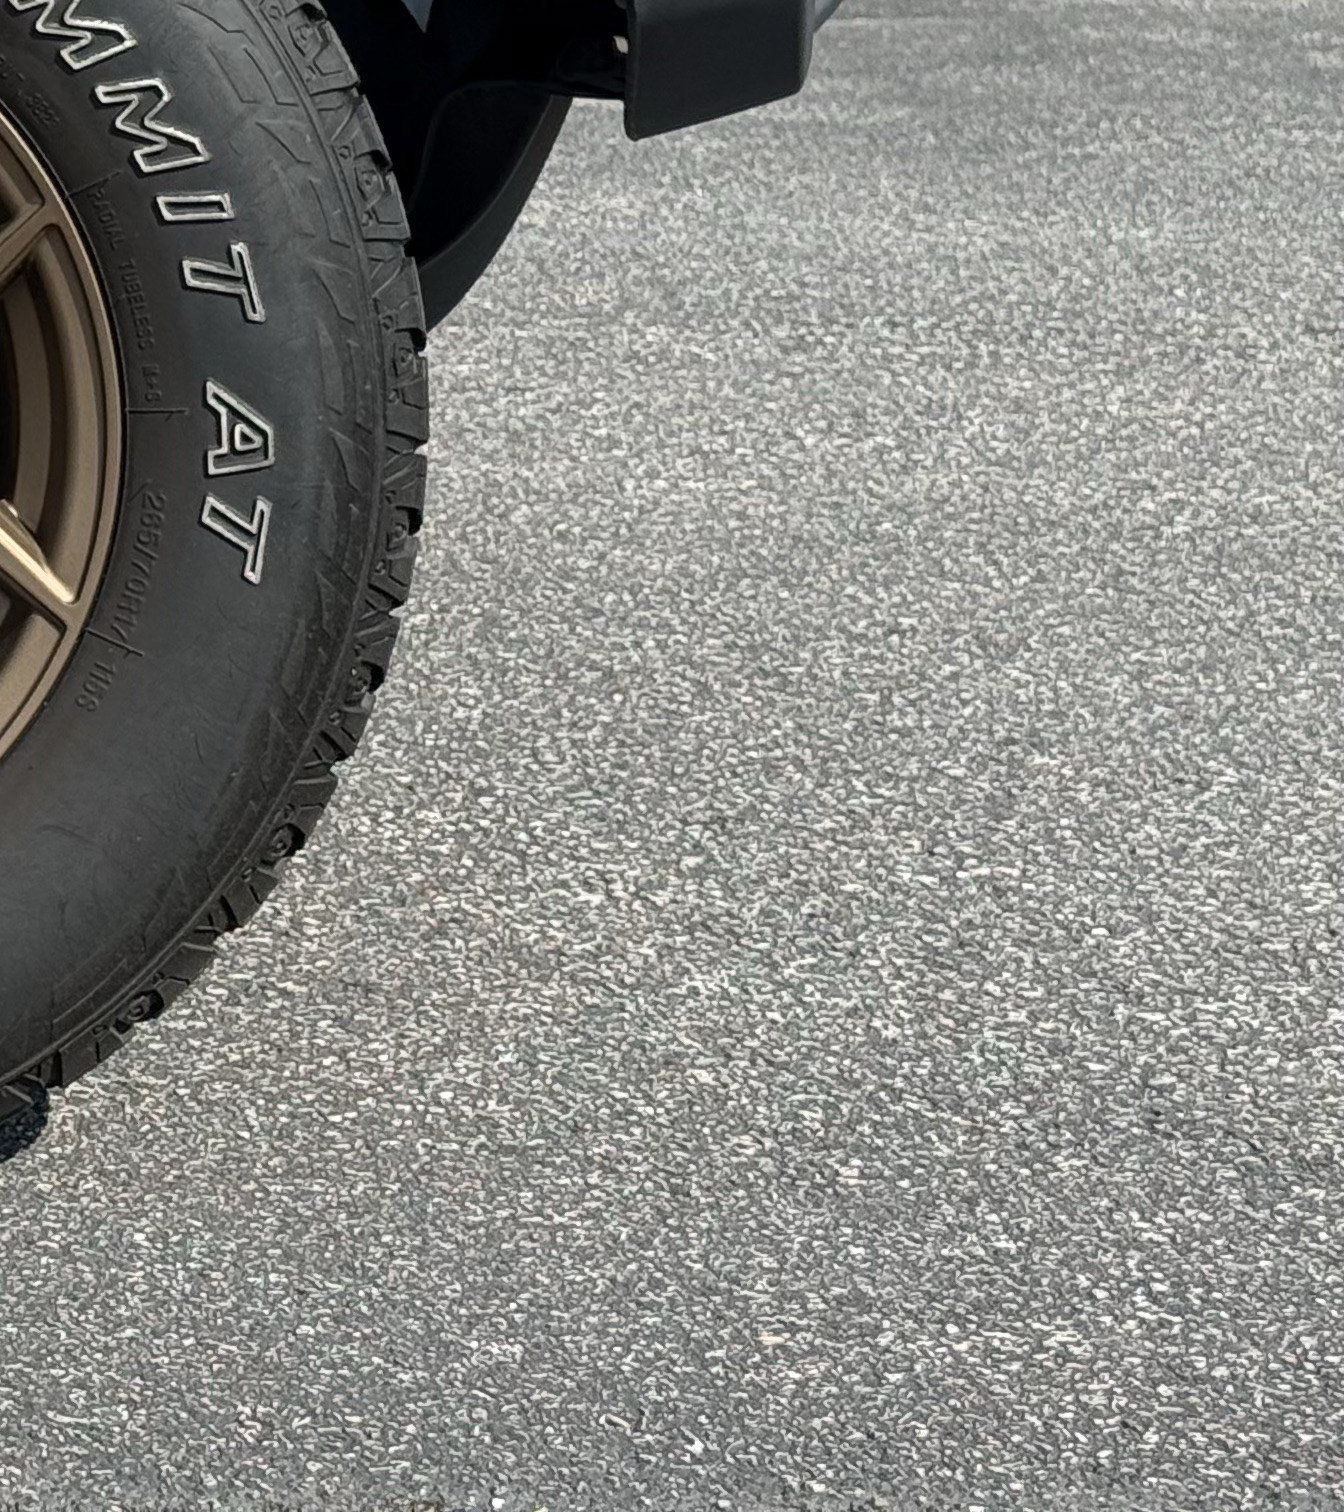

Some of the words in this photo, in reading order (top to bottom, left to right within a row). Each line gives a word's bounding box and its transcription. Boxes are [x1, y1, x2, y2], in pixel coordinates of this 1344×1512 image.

[88, 187, 126, 250] RADIAL
[118, 259, 155, 351] TUBELESS
[201, 378, 276, 586] AT
[111, 491, 166, 644] 265/70R17
